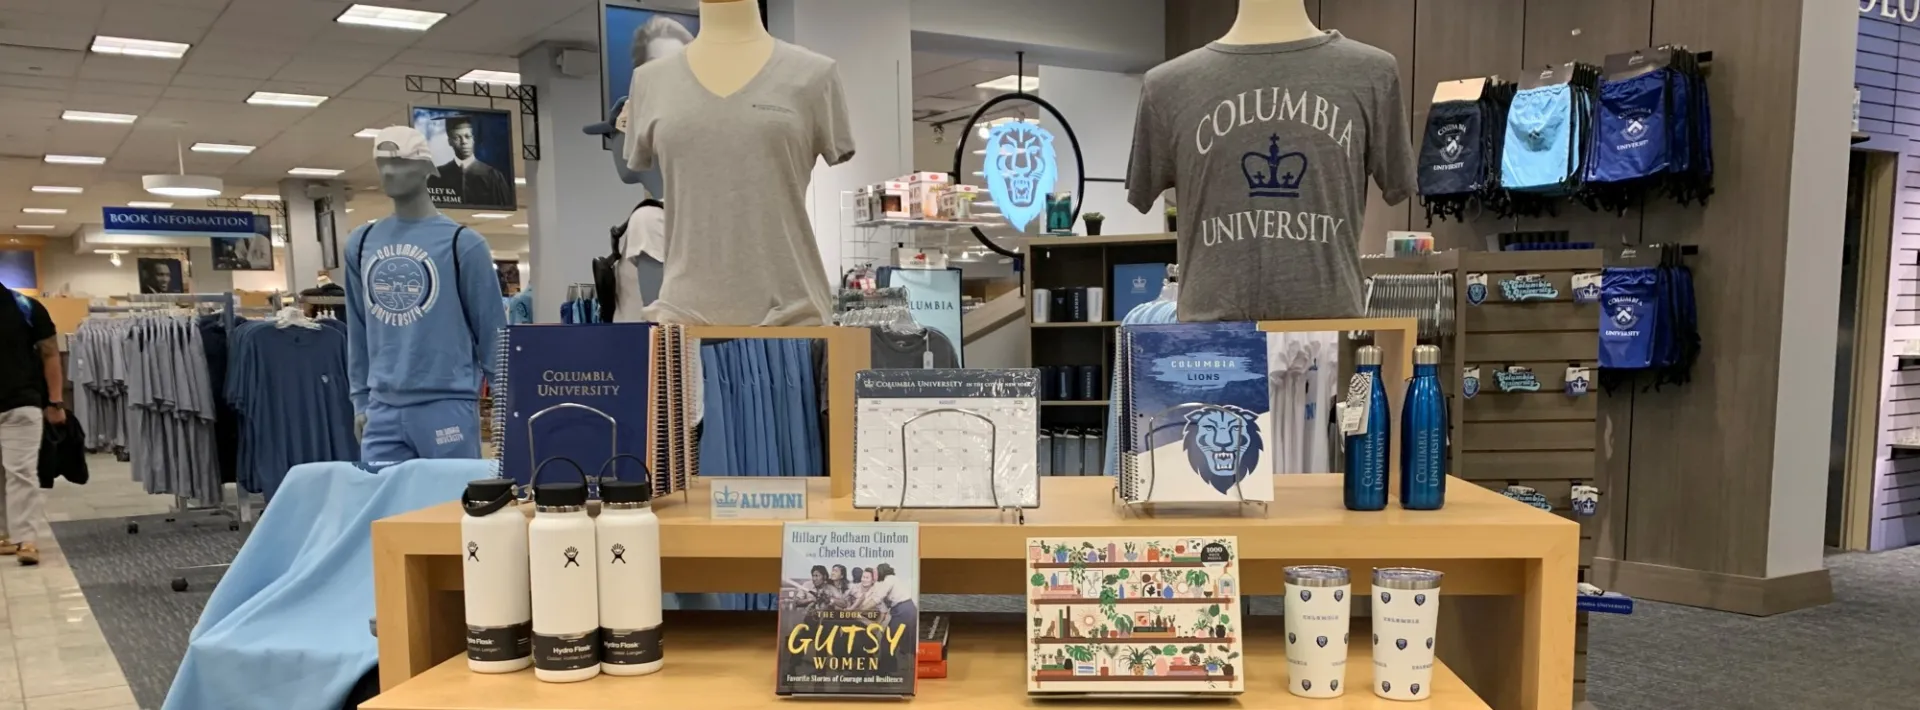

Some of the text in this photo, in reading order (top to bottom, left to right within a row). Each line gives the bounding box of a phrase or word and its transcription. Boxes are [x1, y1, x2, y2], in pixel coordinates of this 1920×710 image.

[1196, 87, 1352, 158] COLUMBIA
[1617, 140, 1649, 150] UNIVERSITY
[1433, 162, 1464, 171] UNIVERSITY
[109, 213, 249, 227] BOOK INFORMATION
[1202, 210, 1344, 247] UNIVERSITY
[376, 243, 428, 261] COLUMBIA
[910, 301, 954, 311] LUMBIA
[1608, 296, 1643, 307] COLUMBIA
[371, 303, 423, 326] UNIVERSITY
[1171, 360, 1235, 368] COLUMBIA
[542, 370, 615, 382] COLUMBIA
[1187, 373, 1220, 381] LIONS
[537, 384, 620, 397] UNIVERSITY
[1361, 433, 1374, 487] COLUMBIA
[1375, 431, 1385, 491] UNIVERSITY
[1416, 429, 1428, 484] COLUMBIA
[1429, 427, 1439, 487] UNIVERSITY
[740, 493, 803, 509] ALUMNI
[792, 531, 909, 545] Hillary Rodham Clinton
[818, 546, 856, 558] Chelsea
[859, 547, 894, 558] Clinton
[603, 640, 620, 649] Hydro
[787, 623, 907, 656] GUTSY
[552, 644, 592, 656] Hydro Flask
[813, 657, 879, 670] WOMEN
[786, 674, 810, 683] Favorite
[811, 674, 831, 683] Stories
[832, 675, 840, 683] of
[840, 675, 863, 684] Courage
